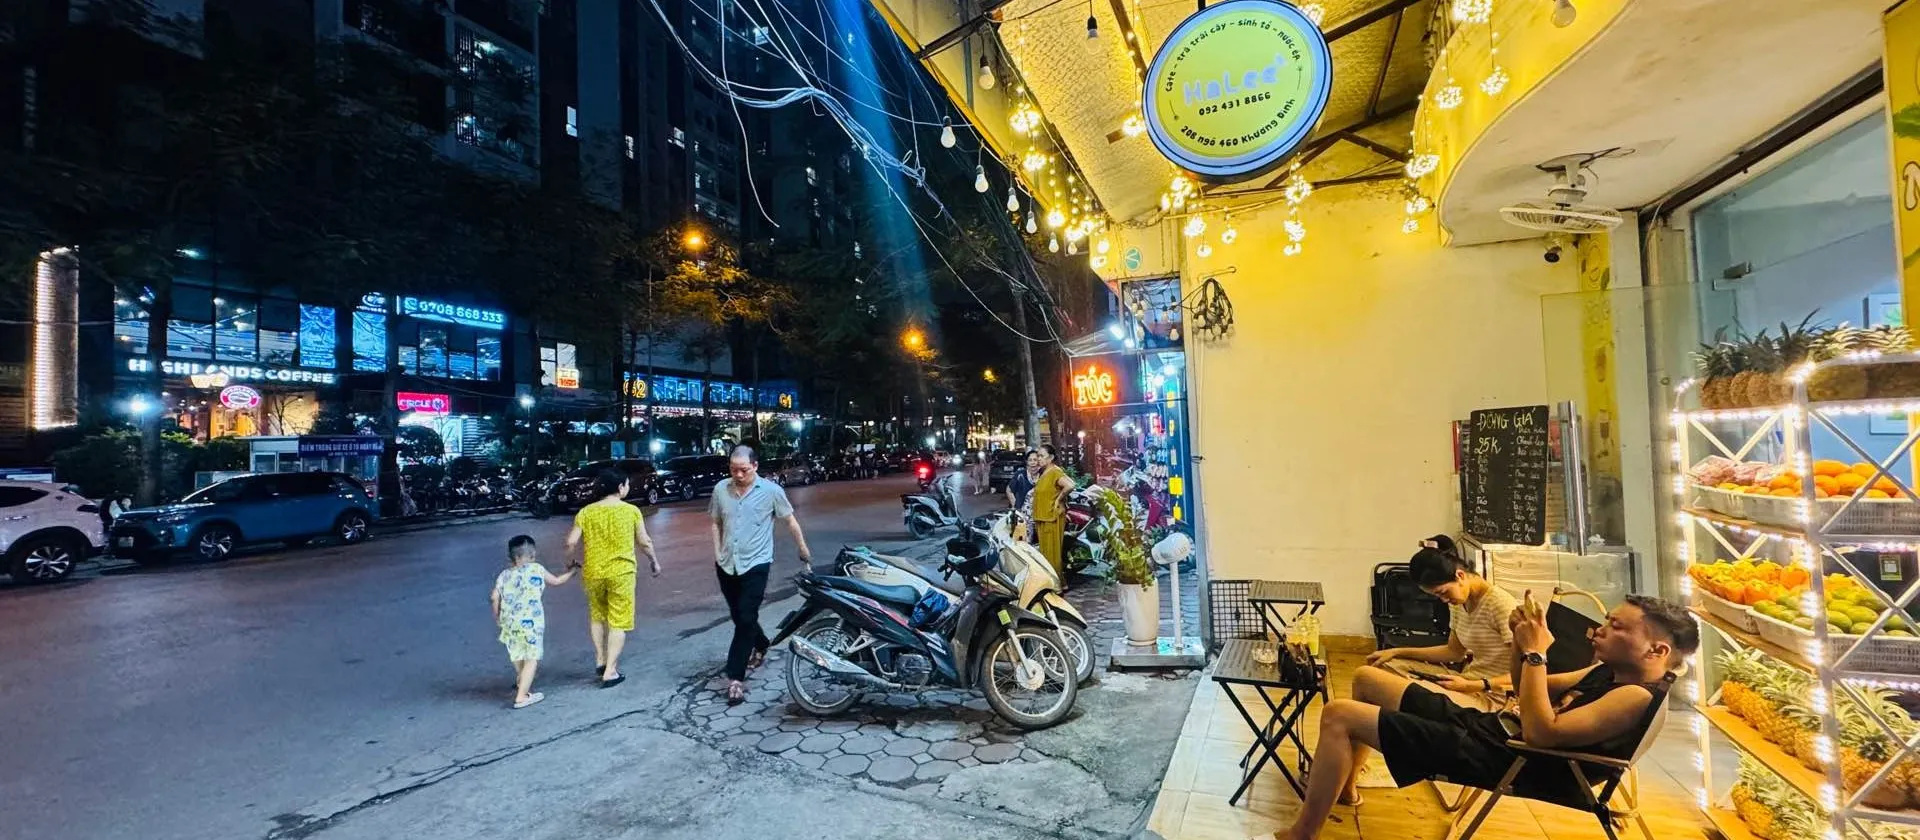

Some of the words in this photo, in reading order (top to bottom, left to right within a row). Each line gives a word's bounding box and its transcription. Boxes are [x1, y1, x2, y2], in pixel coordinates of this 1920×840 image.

[1237, 18, 1257, 27] sinh
[1198, 105, 1218, 116] 092
[1221, 99, 1240, 110] 431
[1244, 92, 1271, 105] 8866
[1219, 138, 1239, 147] 460
[419, 301, 455, 315] 0708
[456, 306, 481, 319] 868
[481, 311, 503, 323] 333
[128, 358, 262, 380] HGHLANDS
[264, 367, 335, 384] COFFEE
[1074, 366, 1113, 406] TÓC
